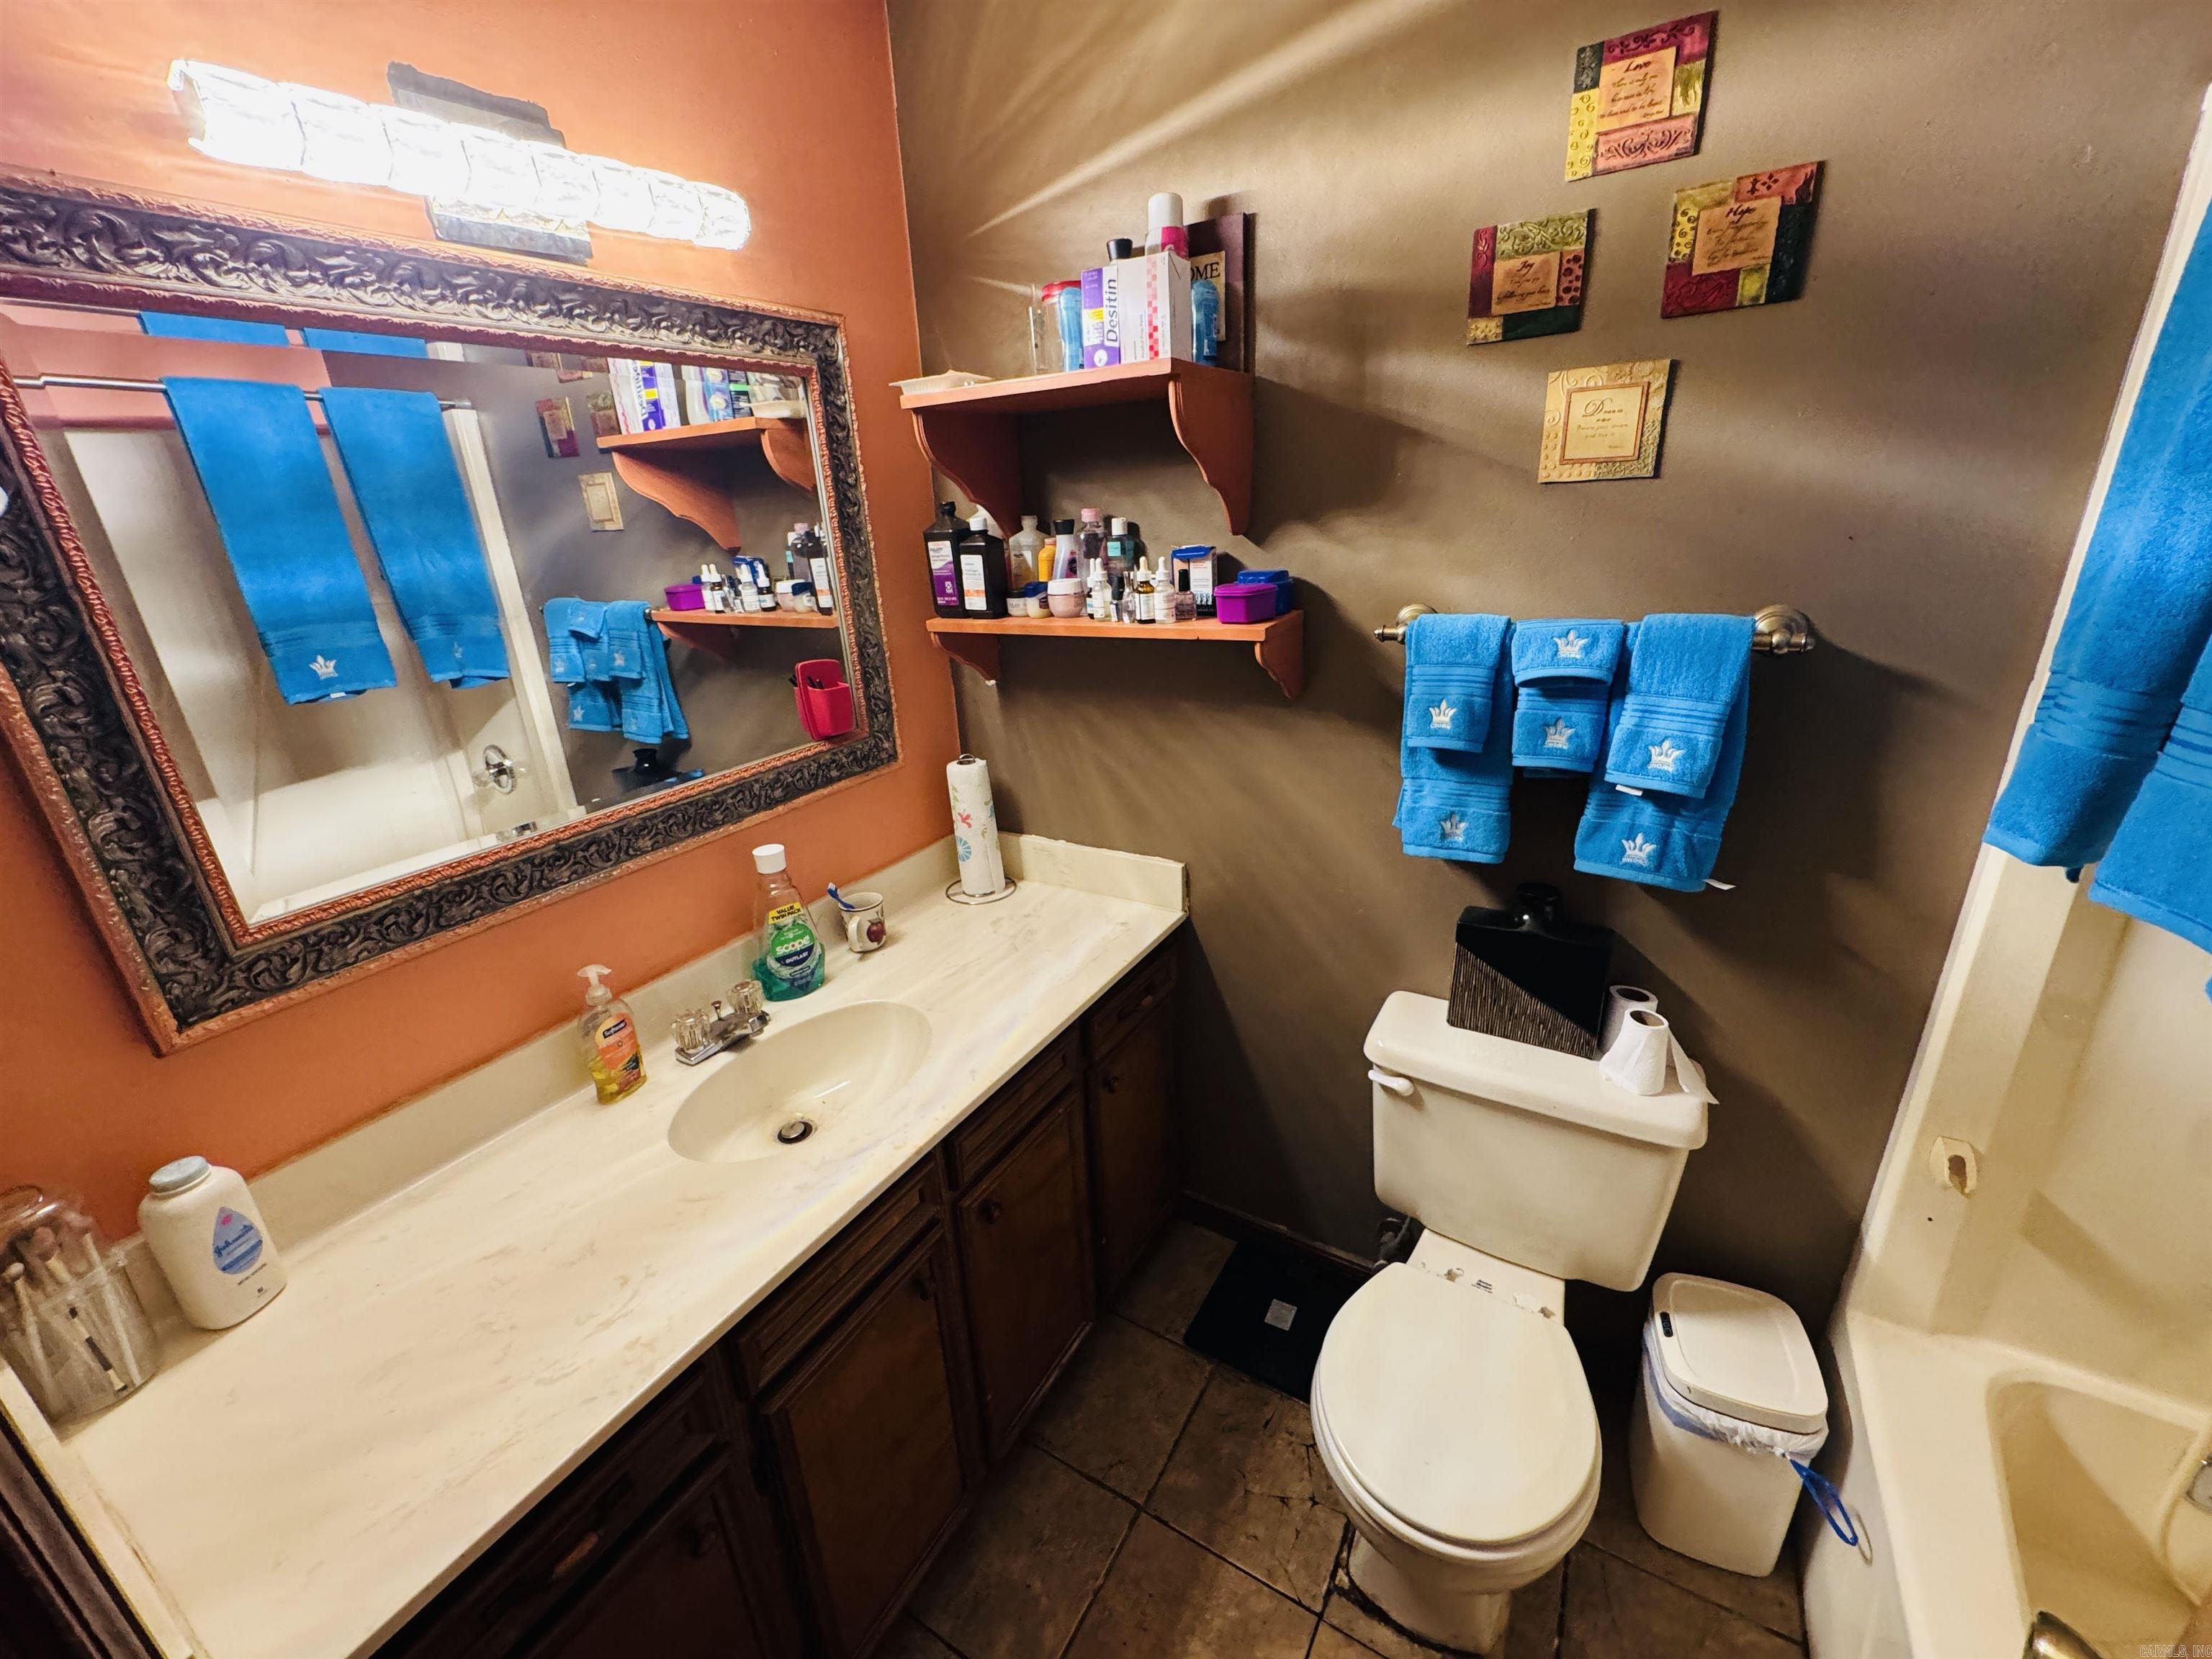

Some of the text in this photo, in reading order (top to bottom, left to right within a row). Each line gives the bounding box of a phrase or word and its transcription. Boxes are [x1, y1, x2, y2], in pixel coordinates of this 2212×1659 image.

[1105, 279, 1118, 342] Desitin
[771, 908, 801, 922] TWIN PACK
[776, 905, 793, 914] VALUE
[786, 951, 809, 963] OUTLAST
